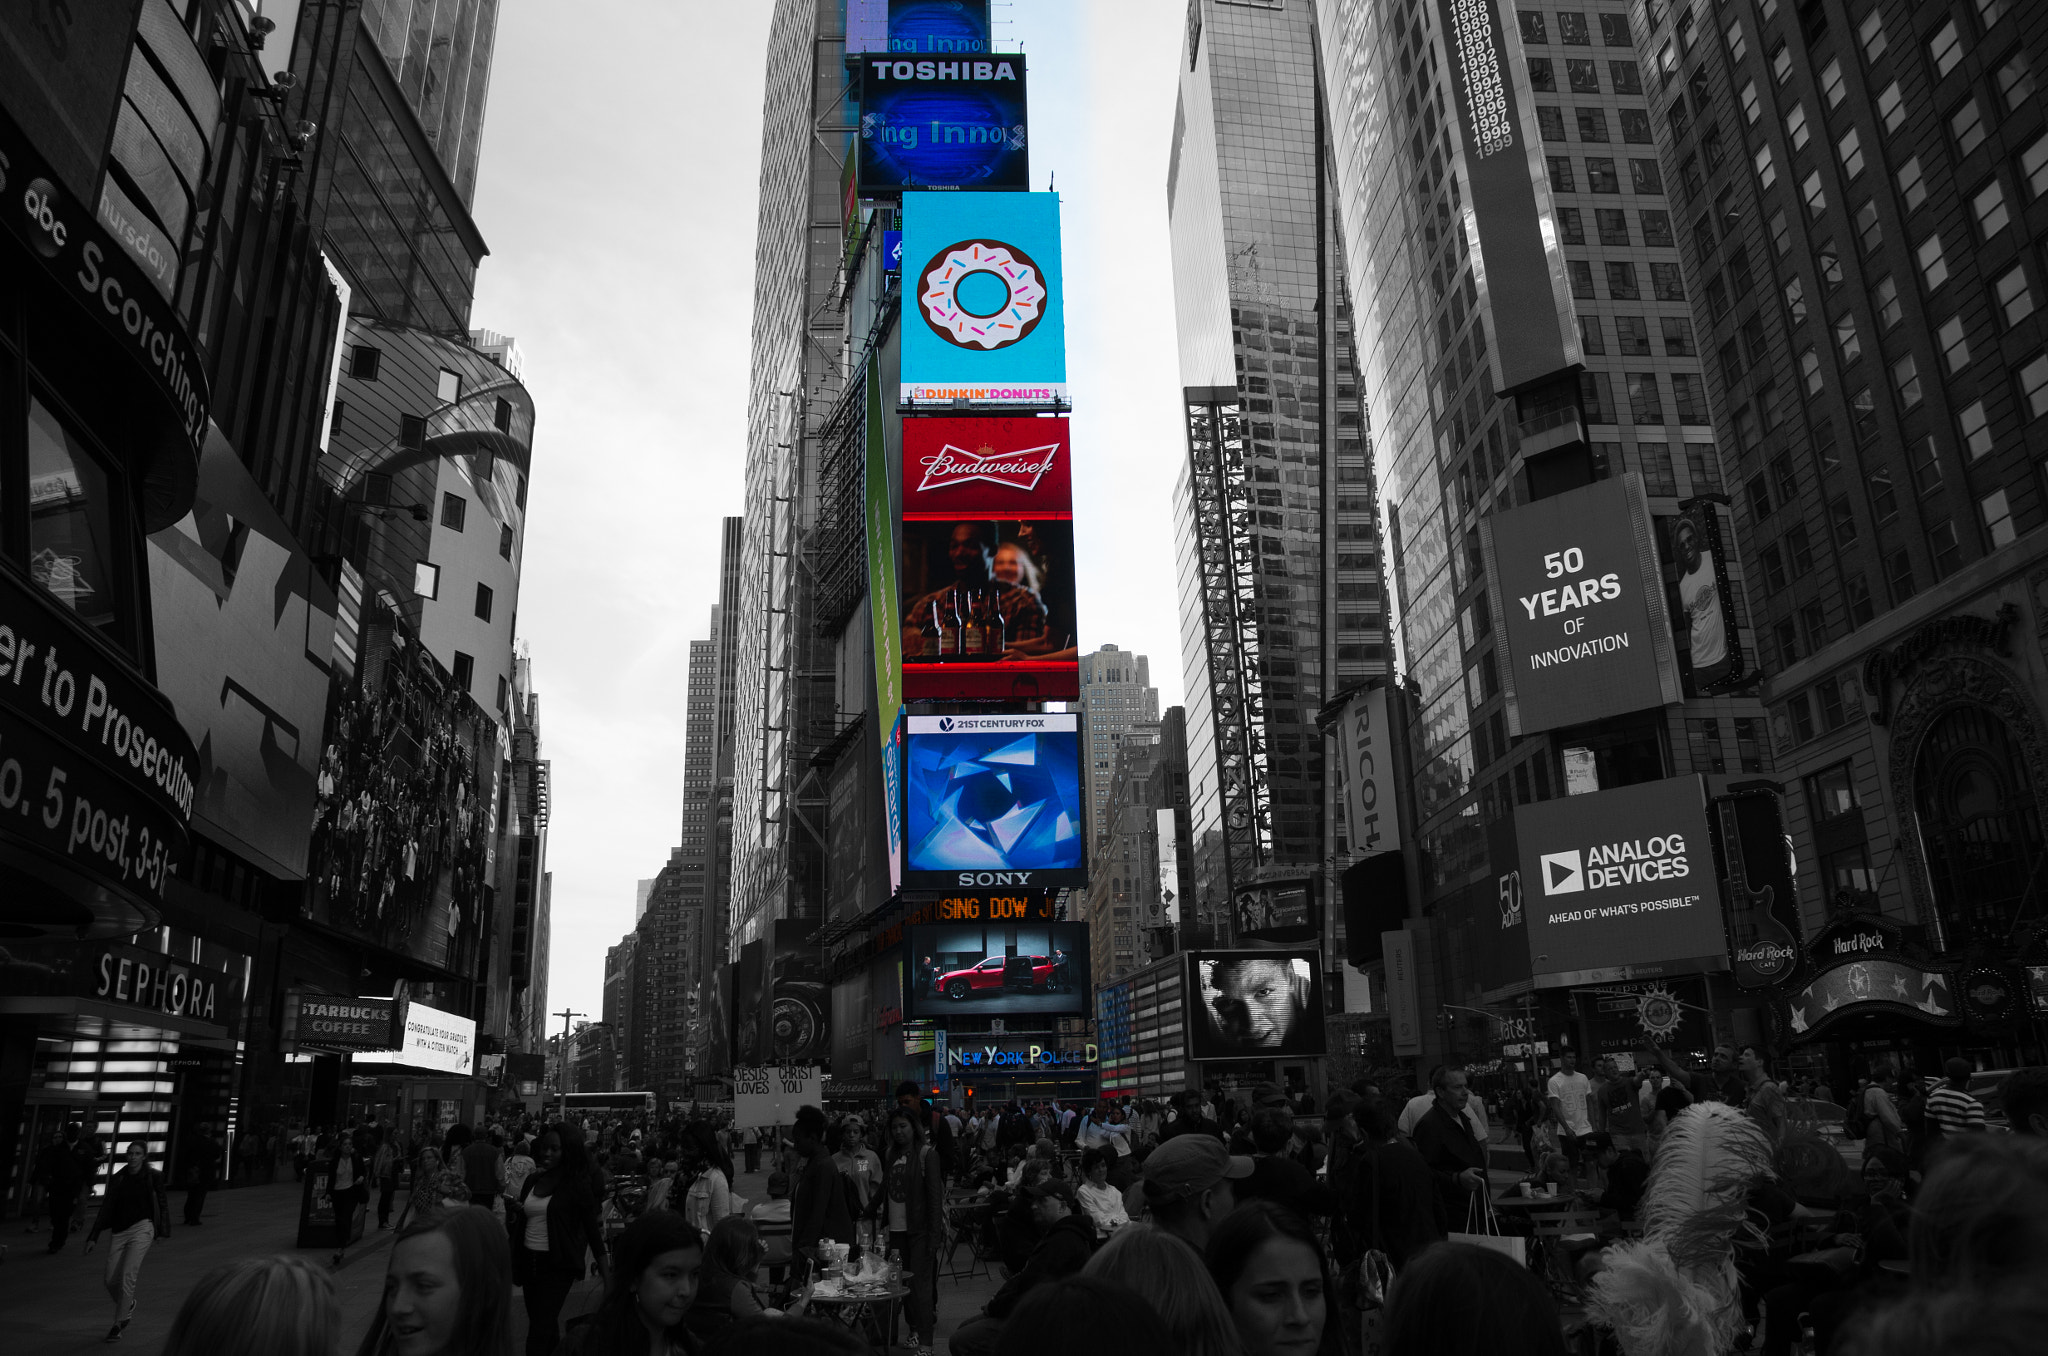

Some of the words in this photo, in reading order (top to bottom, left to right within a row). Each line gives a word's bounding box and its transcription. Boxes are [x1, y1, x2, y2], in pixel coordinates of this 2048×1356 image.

[1451, 0, 1488, 26] 1988
[1454, 12, 1490, 38] 1989
[1456, 24, 1492, 50] 1990
[1458, 36, 1494, 62] 1991
[872, 61, 1016, 81] TOSHIBA
[1460, 49, 1497, 74] 1992
[1462, 61, 1499, 87] 1993
[1465, 73, 1501, 99] 1994
[1467, 85, 1504, 111] 1995
[1469, 97, 1506, 123] 1996
[1472, 109, 1508, 135] 1997
[1474, 122, 1510, 147] 1998
[1476, 134, 1512, 160] 1999
[24, 189, 68, 247] abc
[77, 240, 201, 431] Scorching
[990, 389, 1050, 399] DONUTS
[920, 455, 1053, 477] Budweiser
[1544, 547, 1584, 579] 50
[1519, 573, 1622, 621] YEARS
[1563, 617, 1585, 636] OF
[1530, 632, 1629, 670] INNOVATION
[0, 624, 36, 686] er
[41, 645, 76, 718] to
[82, 674, 194, 822] Prosecutors
[958, 720, 979, 728] 21ST
[980, 720, 1025, 728] CENTURY
[1026, 719, 1045, 727] FOX
[1354, 704, 1381, 845] RICOH
[0, 745, 30, 817] o.
[42, 765, 67, 830] 5
[67, 795, 131, 881] post,
[1587, 833, 1686, 867] ANALOG
[958, 872, 1032, 887] SONY
[1588, 856, 1690, 890] DEVICES
[1499, 870, 1522, 914] 50
[989, 896, 1029, 918] DOW
[1548, 910, 1582, 925] AHEAD
[1584, 908, 1598, 920] OF
[1599, 903, 1638, 918] WHAT'S
[1737, 947, 1766, 962] Hard
[1765, 944, 1794, 960] Rock
[1834, 937, 1857, 955] Hard
[1858, 930, 1884, 952] Rock
[1635, 967, 1663, 975] REUTERS
[1758, 960, 1776, 969] CAFE
[97, 952, 215, 1019] SEPHORA
[302, 1003, 391, 1020] STARBUCKS
[312, 1020, 371, 1034] COFFEE
[948, 1045, 983, 1067] NEW
[984, 1045, 1024, 1066] YORK
[1029, 1044, 1081, 1065] POLICE
[734, 1067, 769, 1082] JESUS
[736, 1080, 770, 1094] LOVES
[780, 1080, 803, 1094] YOU
